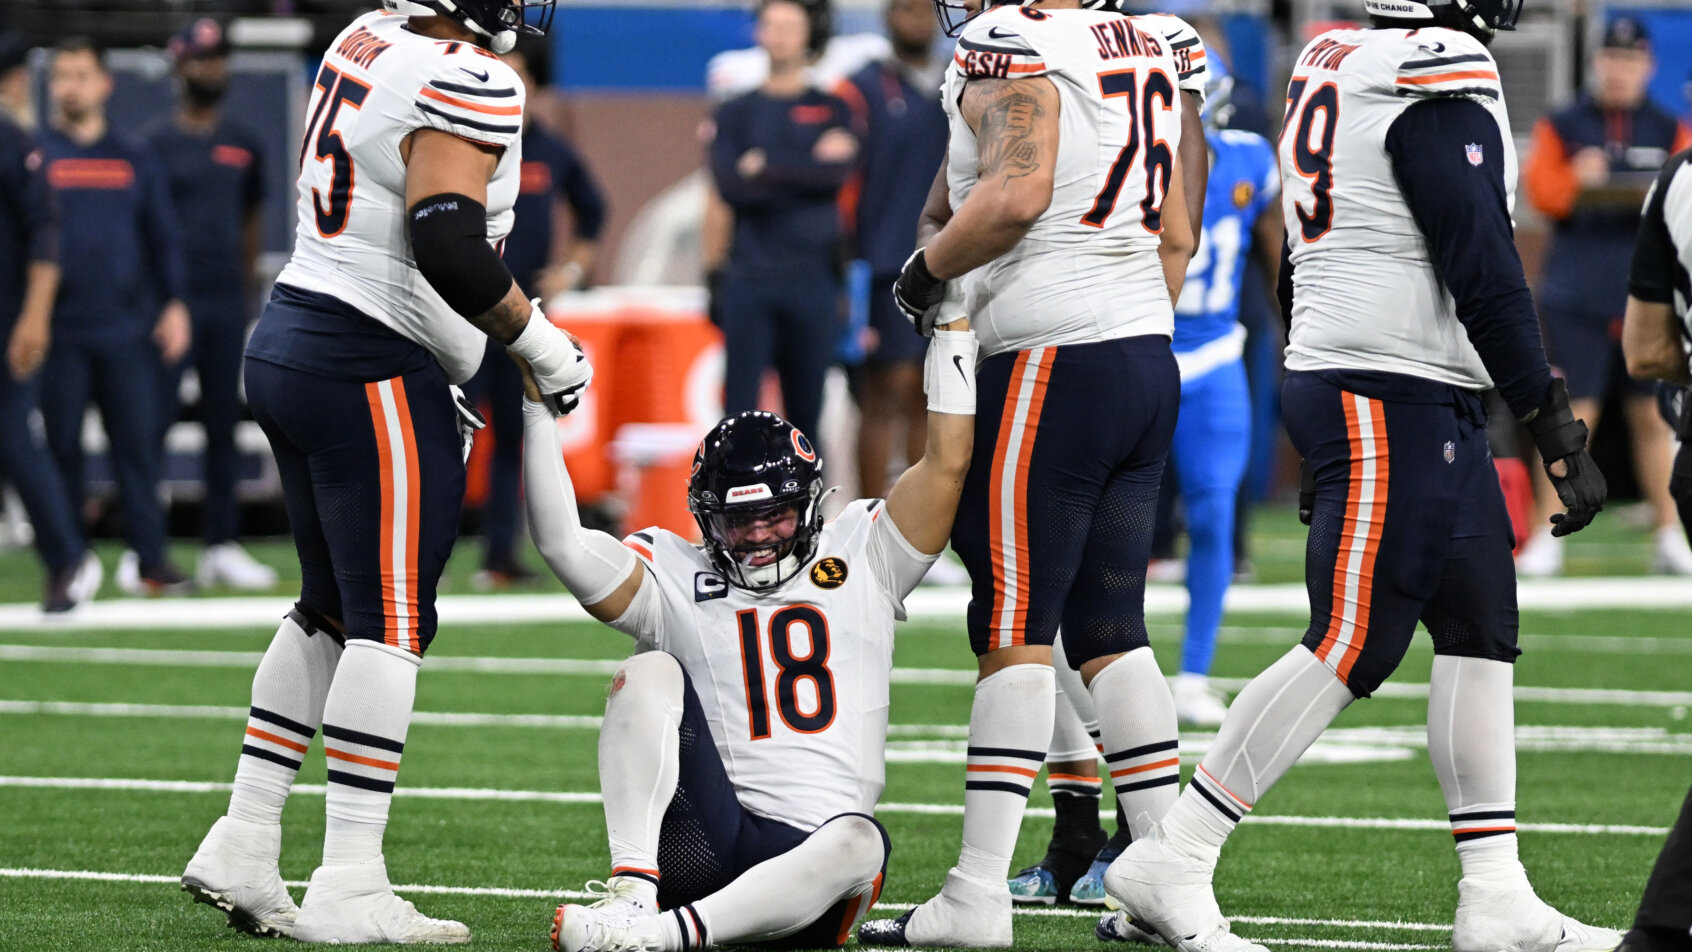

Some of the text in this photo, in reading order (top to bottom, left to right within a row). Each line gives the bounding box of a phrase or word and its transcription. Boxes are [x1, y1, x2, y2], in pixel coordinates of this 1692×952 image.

[965, 50, 1012, 79] GSH
[1380, 3, 1414, 12] CHANGE
[297, 61, 373, 238] 75
[1080, 68, 1173, 235] 76
[1281, 75, 1340, 243] 79
[731, 487, 764, 497] BEARS
[736, 603, 837, 741] 18
